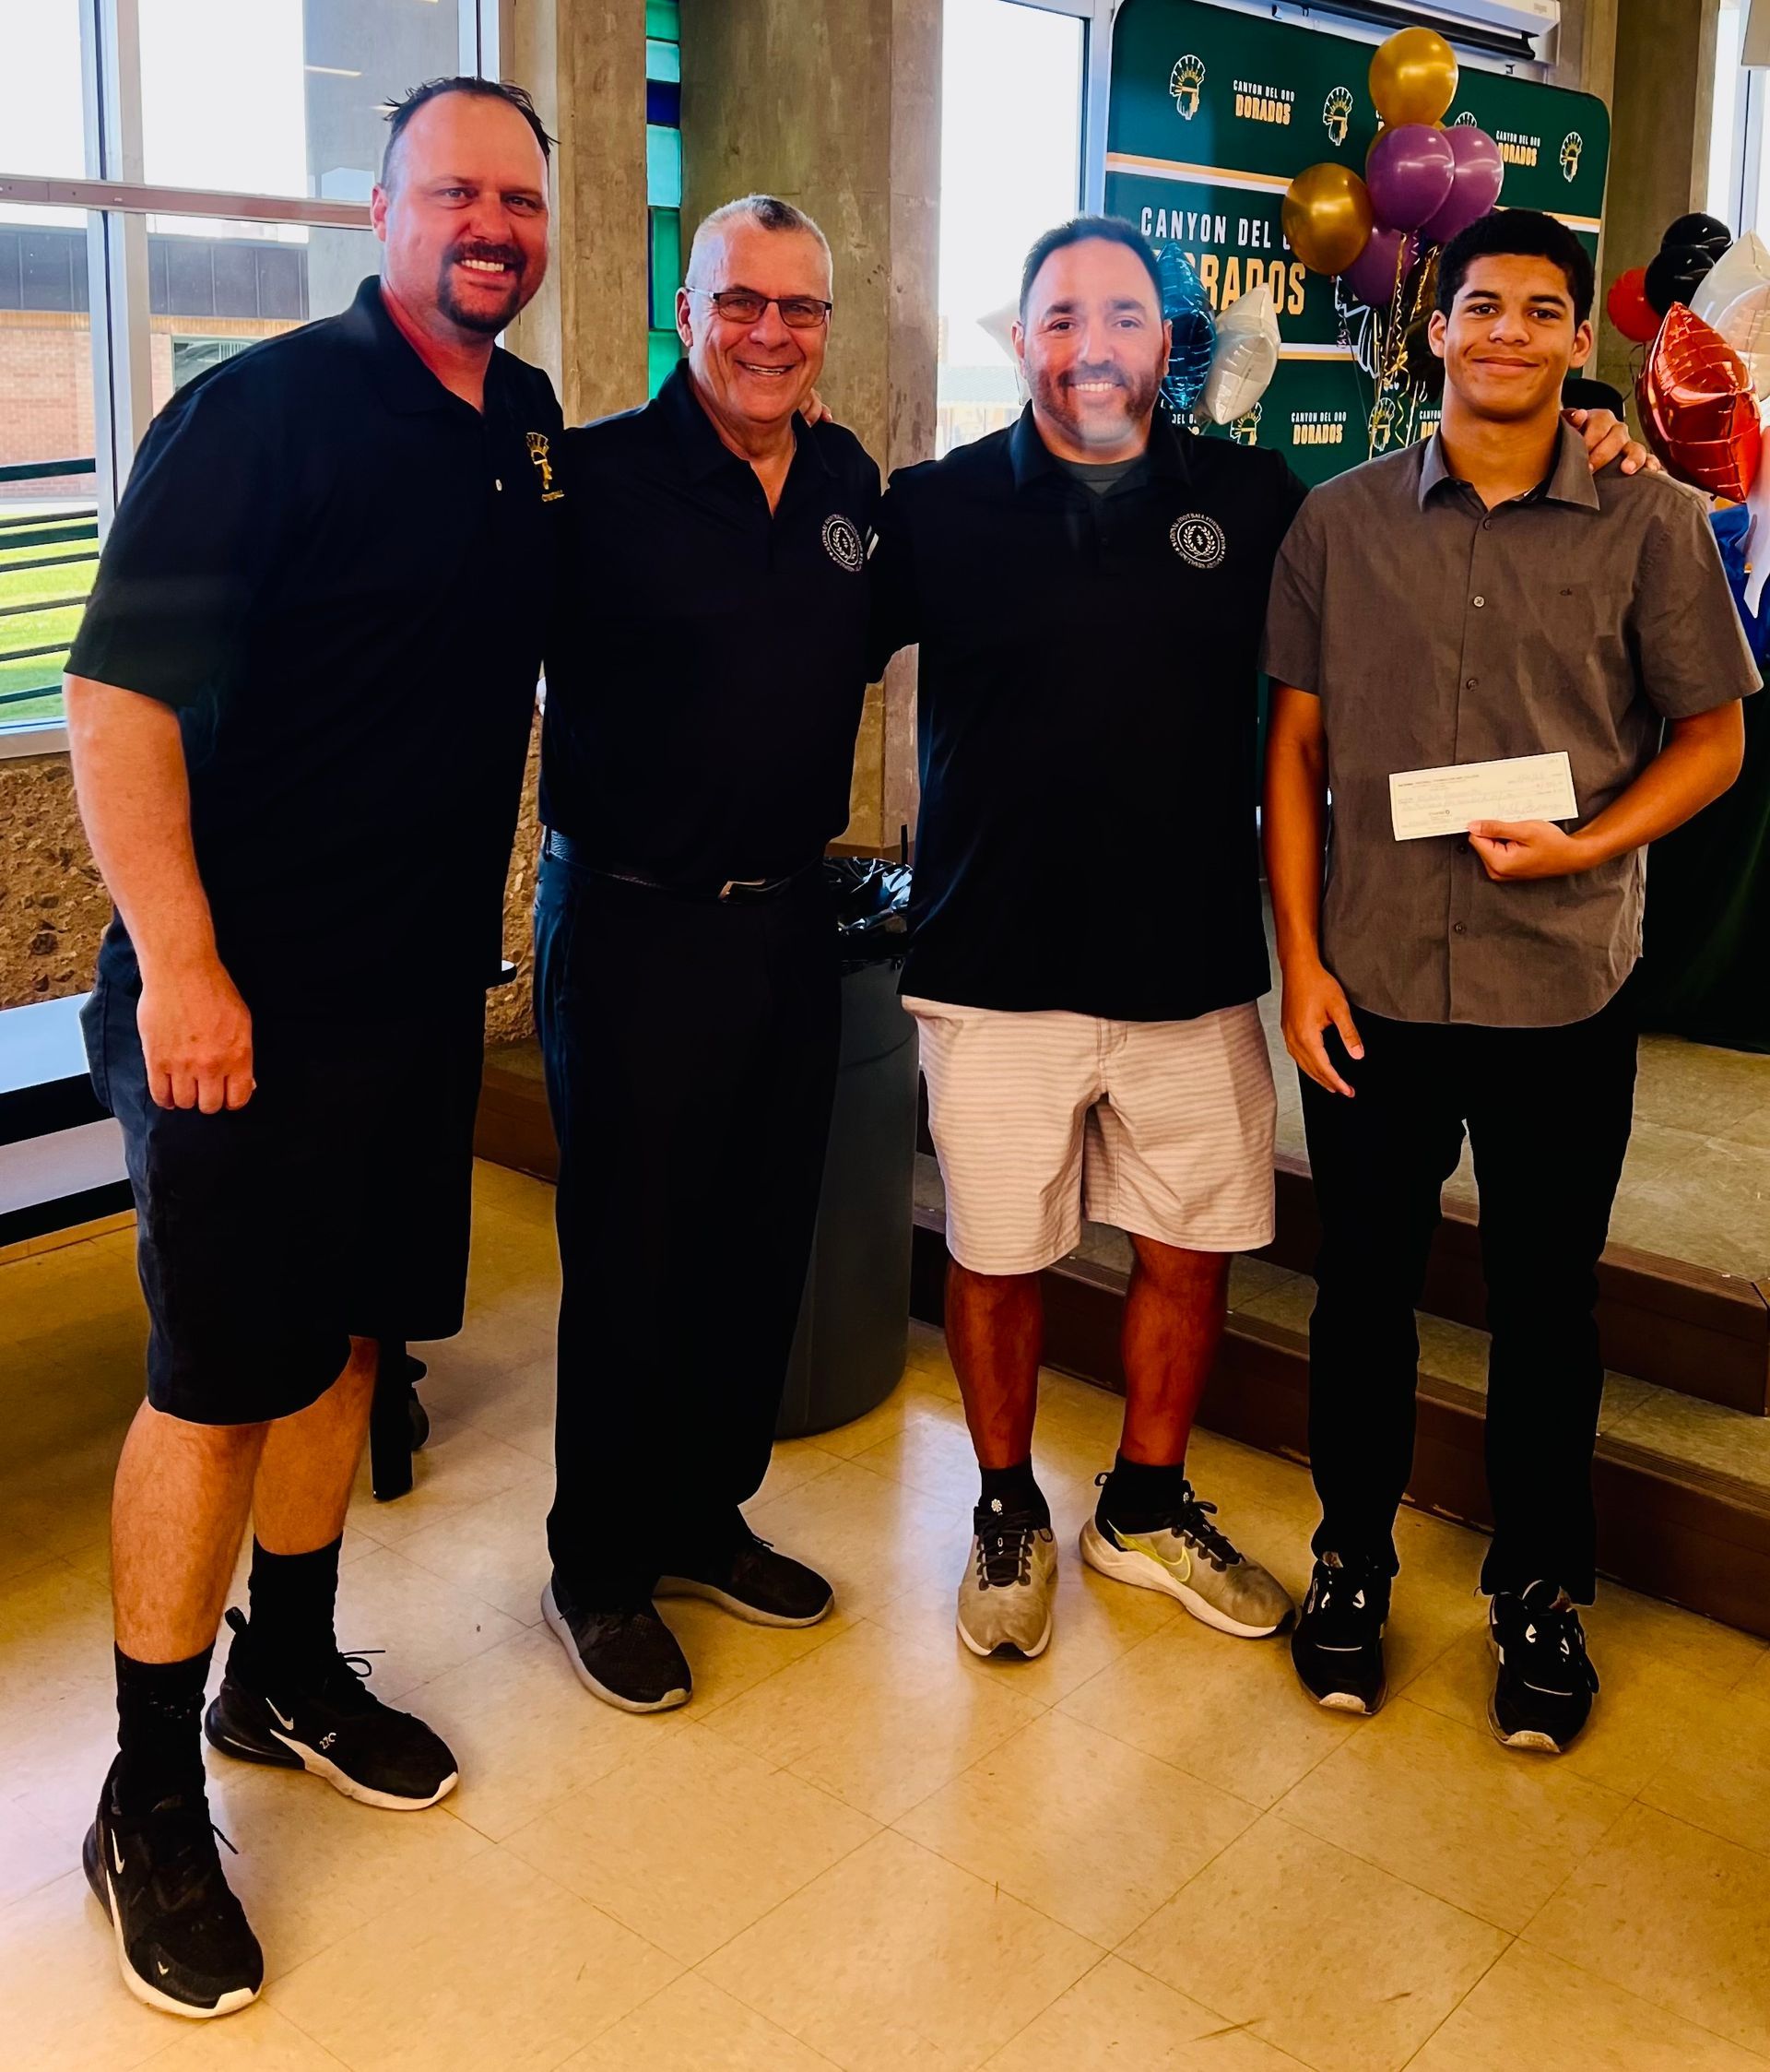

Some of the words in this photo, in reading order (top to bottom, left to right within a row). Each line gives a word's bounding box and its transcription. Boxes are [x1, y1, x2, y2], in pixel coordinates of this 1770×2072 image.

[1233, 79, 1262, 95] CANYON
[1265, 86, 1278, 99] DEL
[1280, 89, 1294, 102] ORO
[1235, 94, 1291, 124] DORADOS
[1140, 207, 1226, 244] CANYON
[1238, 218, 1270, 249] DEL
[1152, 248, 1305, 315] RADOS
[1291, 412, 1314, 422] CANYON
[1319, 411, 1331, 422] DEL
[1334, 411, 1347, 422] ORO
[1292, 423, 1343, 444] DORADOS
